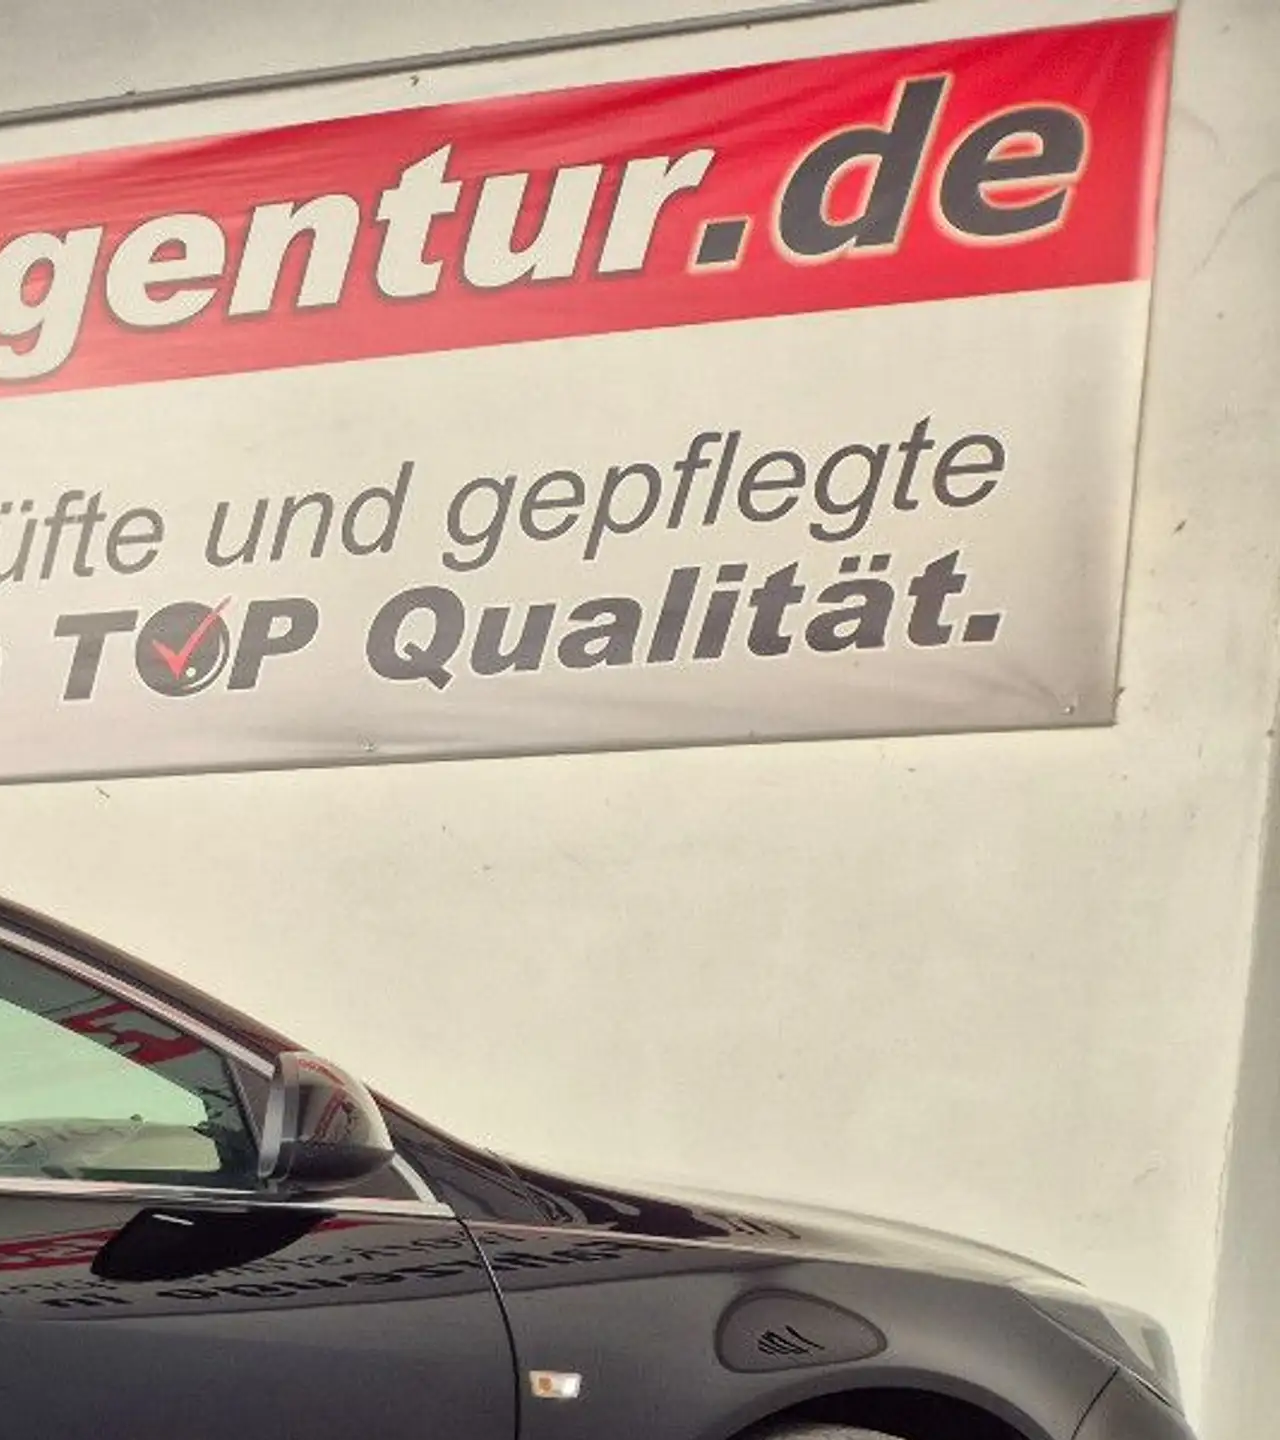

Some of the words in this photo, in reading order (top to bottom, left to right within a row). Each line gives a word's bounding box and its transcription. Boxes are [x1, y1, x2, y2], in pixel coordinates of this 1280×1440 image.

[203, 461, 414, 566] und
[439, 415, 1006, 571] gepflegte
[53, 597, 320, 699] TOP
[363, 548, 1002, 690] Qualität.
